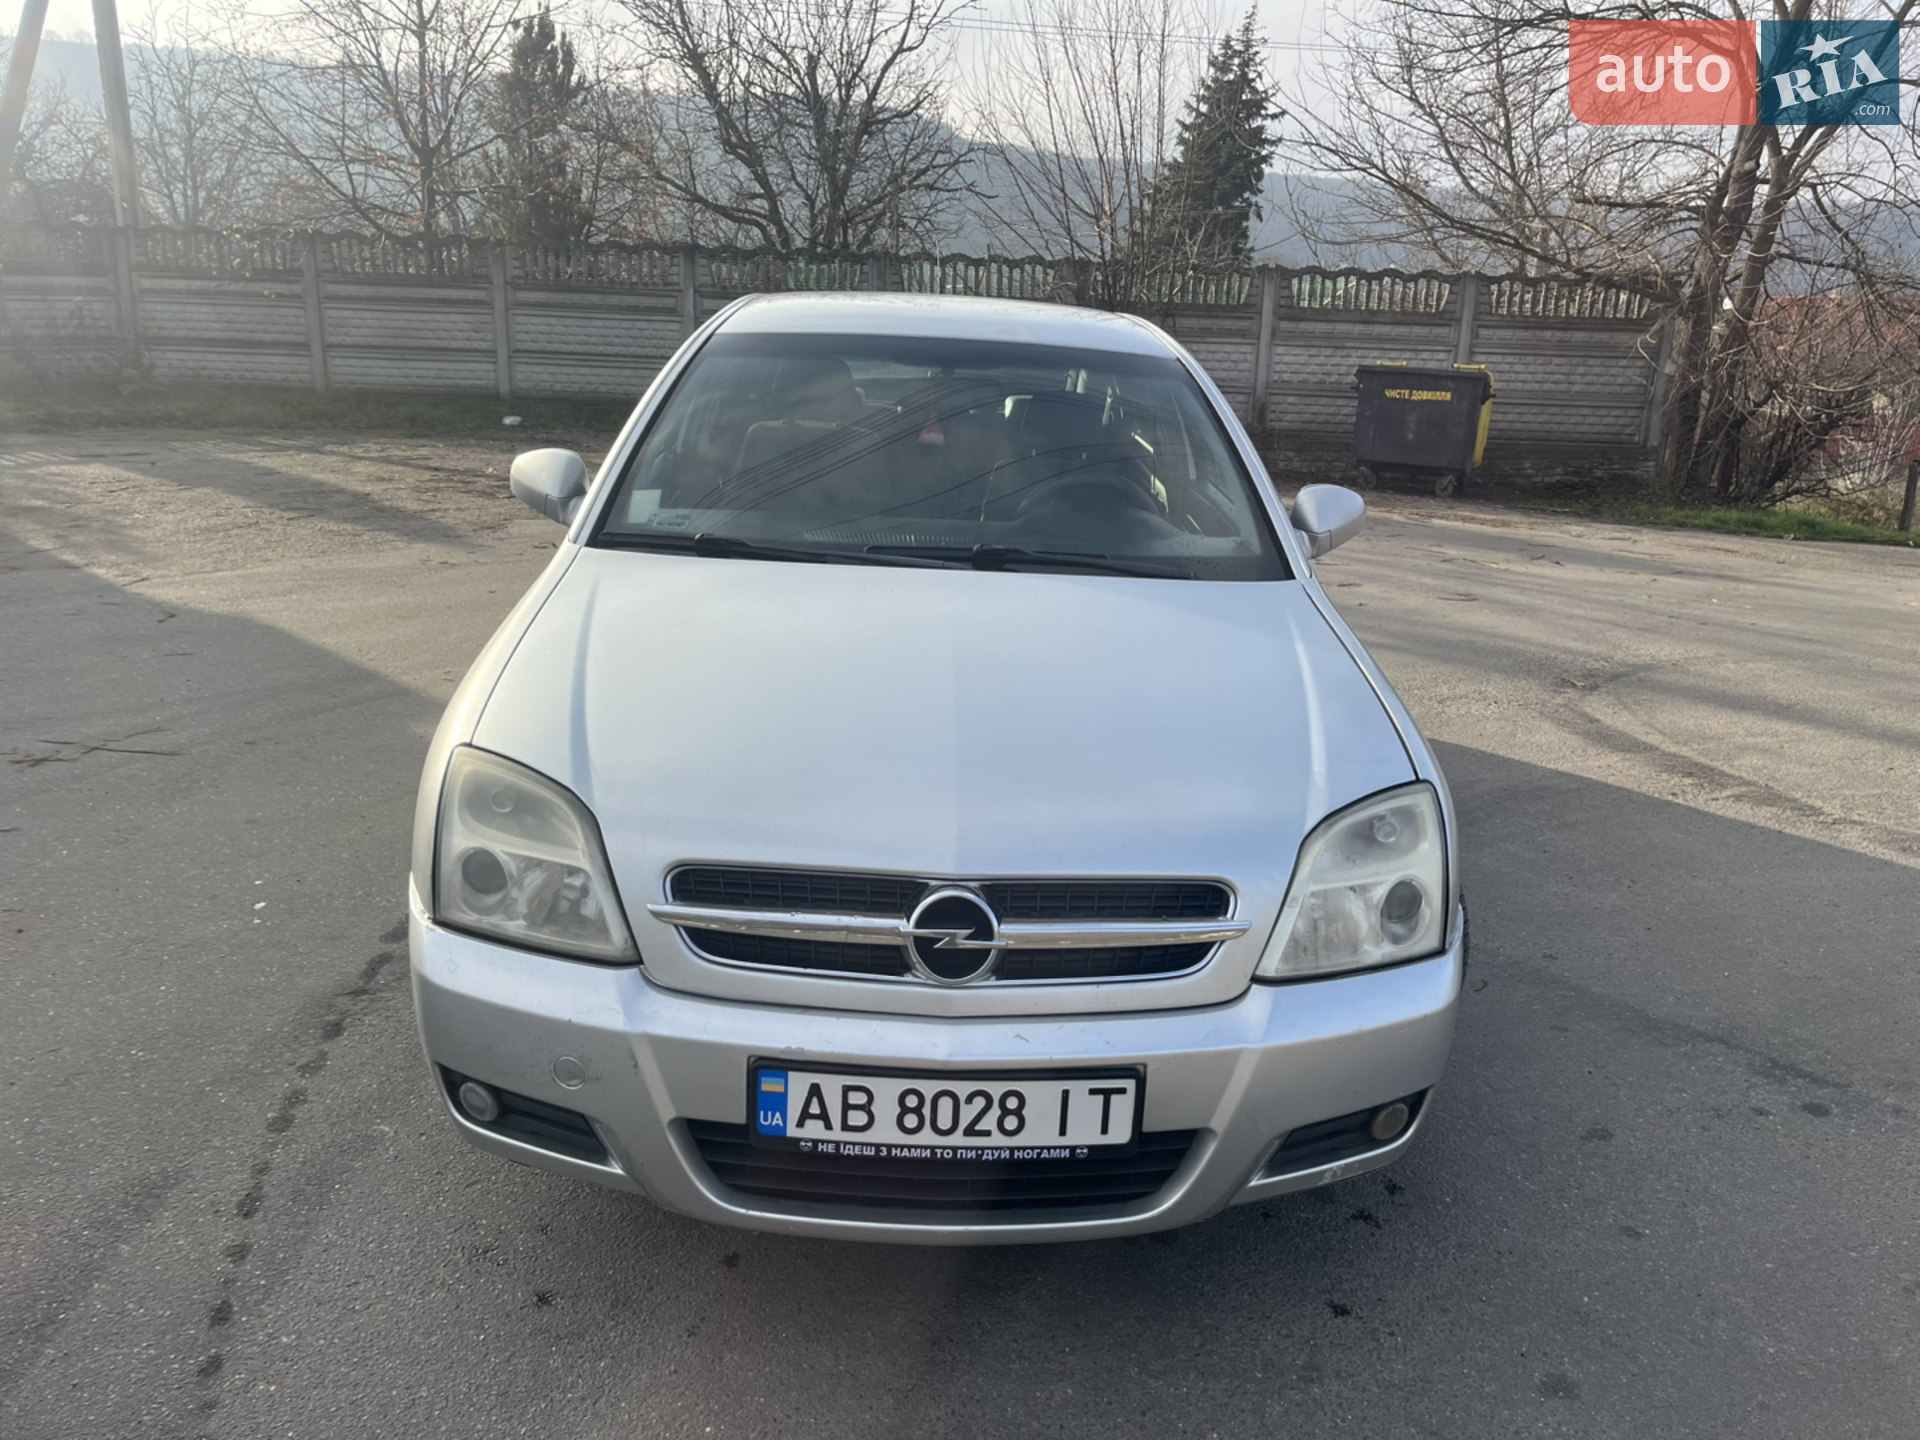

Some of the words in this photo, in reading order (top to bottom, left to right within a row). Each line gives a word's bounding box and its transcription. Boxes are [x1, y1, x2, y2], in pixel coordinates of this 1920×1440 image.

[1384, 388, 1410, 399] ЧИСТЕ
[795, 1082, 875, 1133] AB
[896, 1087, 1026, 1137] 8028
[1058, 1087, 1127, 1137] IT
[759, 1110, 784, 1127] UA
[818, 1142, 836, 1153] НЕ
[840, 1143, 875, 1156] ЇДЕШ
[891, 1145, 931, 1158] НАМИ
[936, 1148, 953, 1159] ТО
[1014, 1148, 1070, 1159] НОГАМИ
